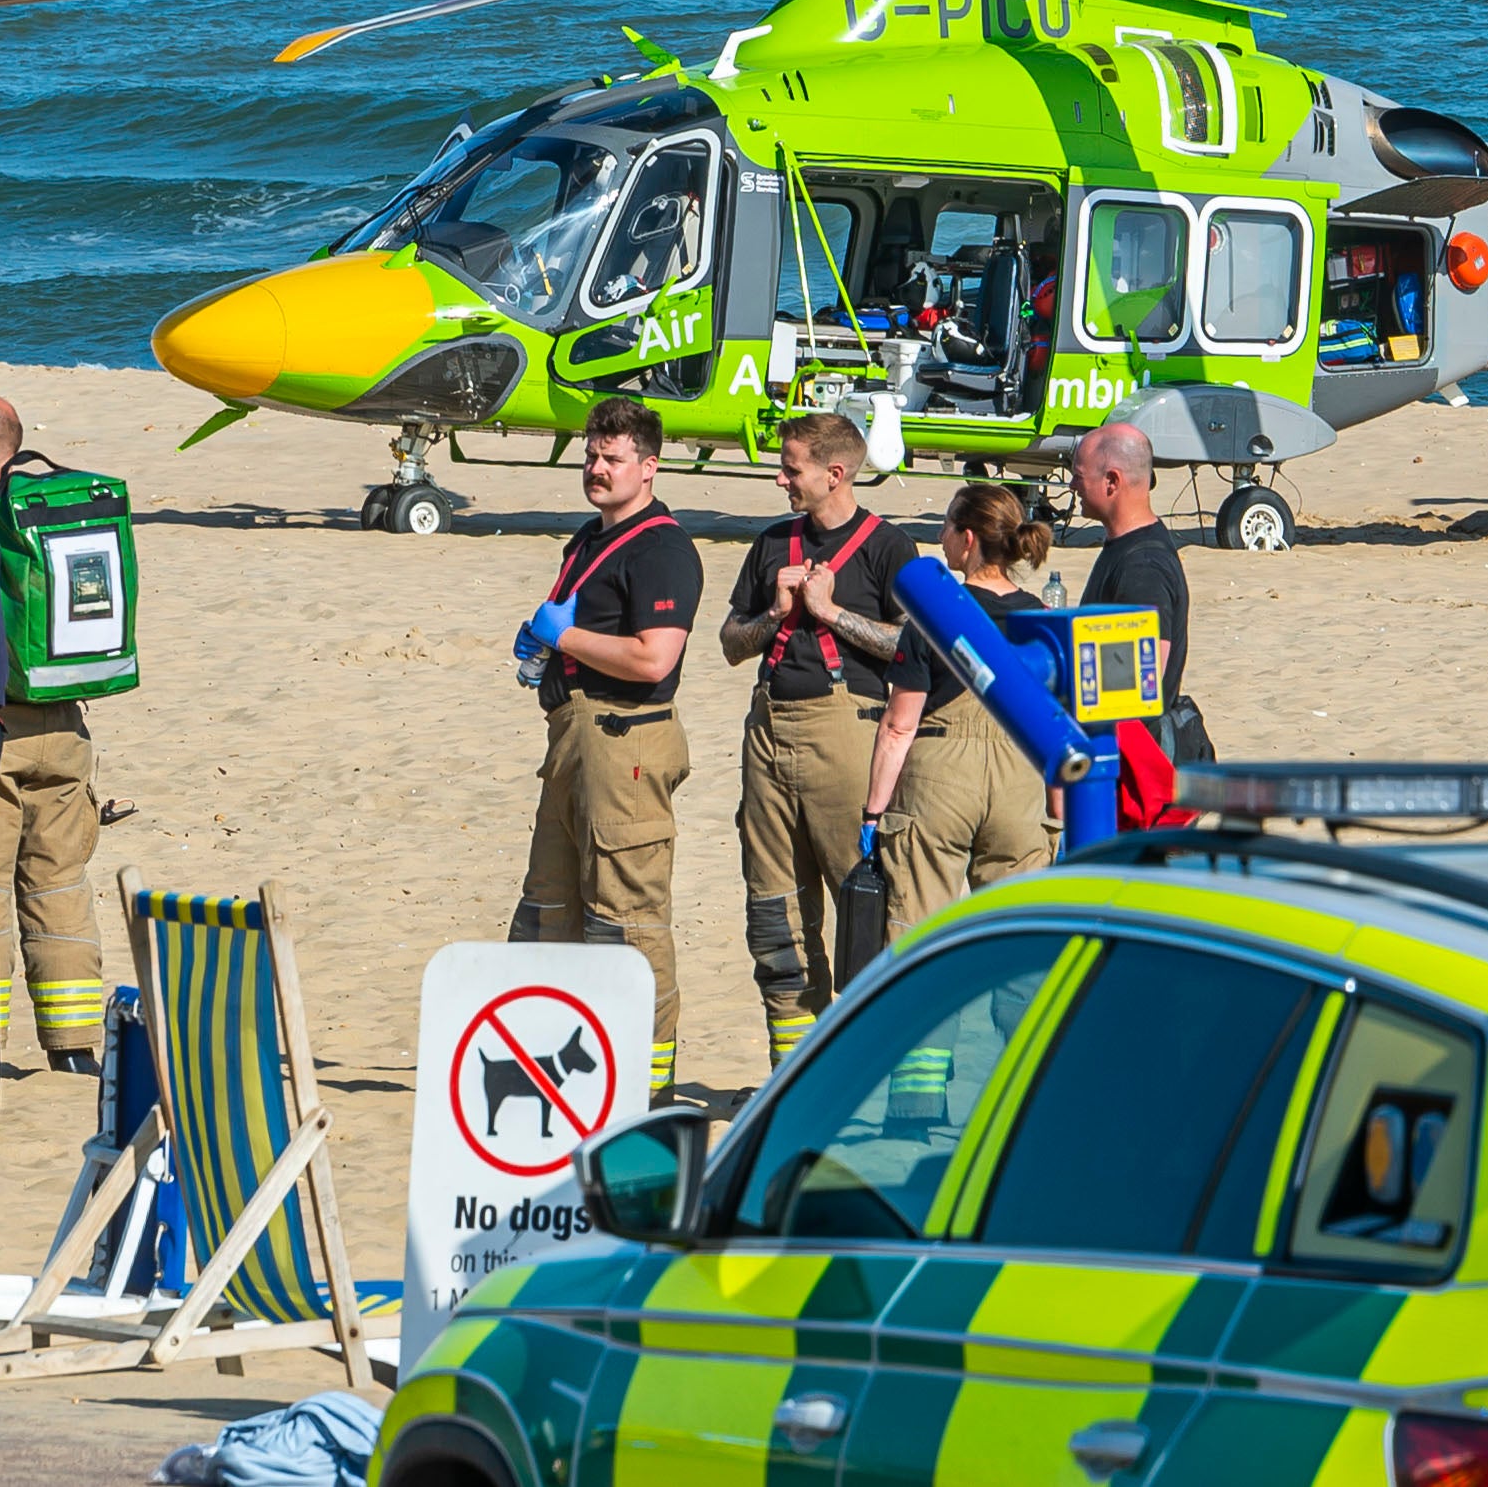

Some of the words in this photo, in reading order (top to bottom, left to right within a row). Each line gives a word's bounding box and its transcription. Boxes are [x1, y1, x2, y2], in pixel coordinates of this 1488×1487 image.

[639, 309, 702, 361] Air
[454, 1196, 497, 1231] No
[509, 1198, 593, 1241] dogs
[450, 1253, 476, 1273] on
